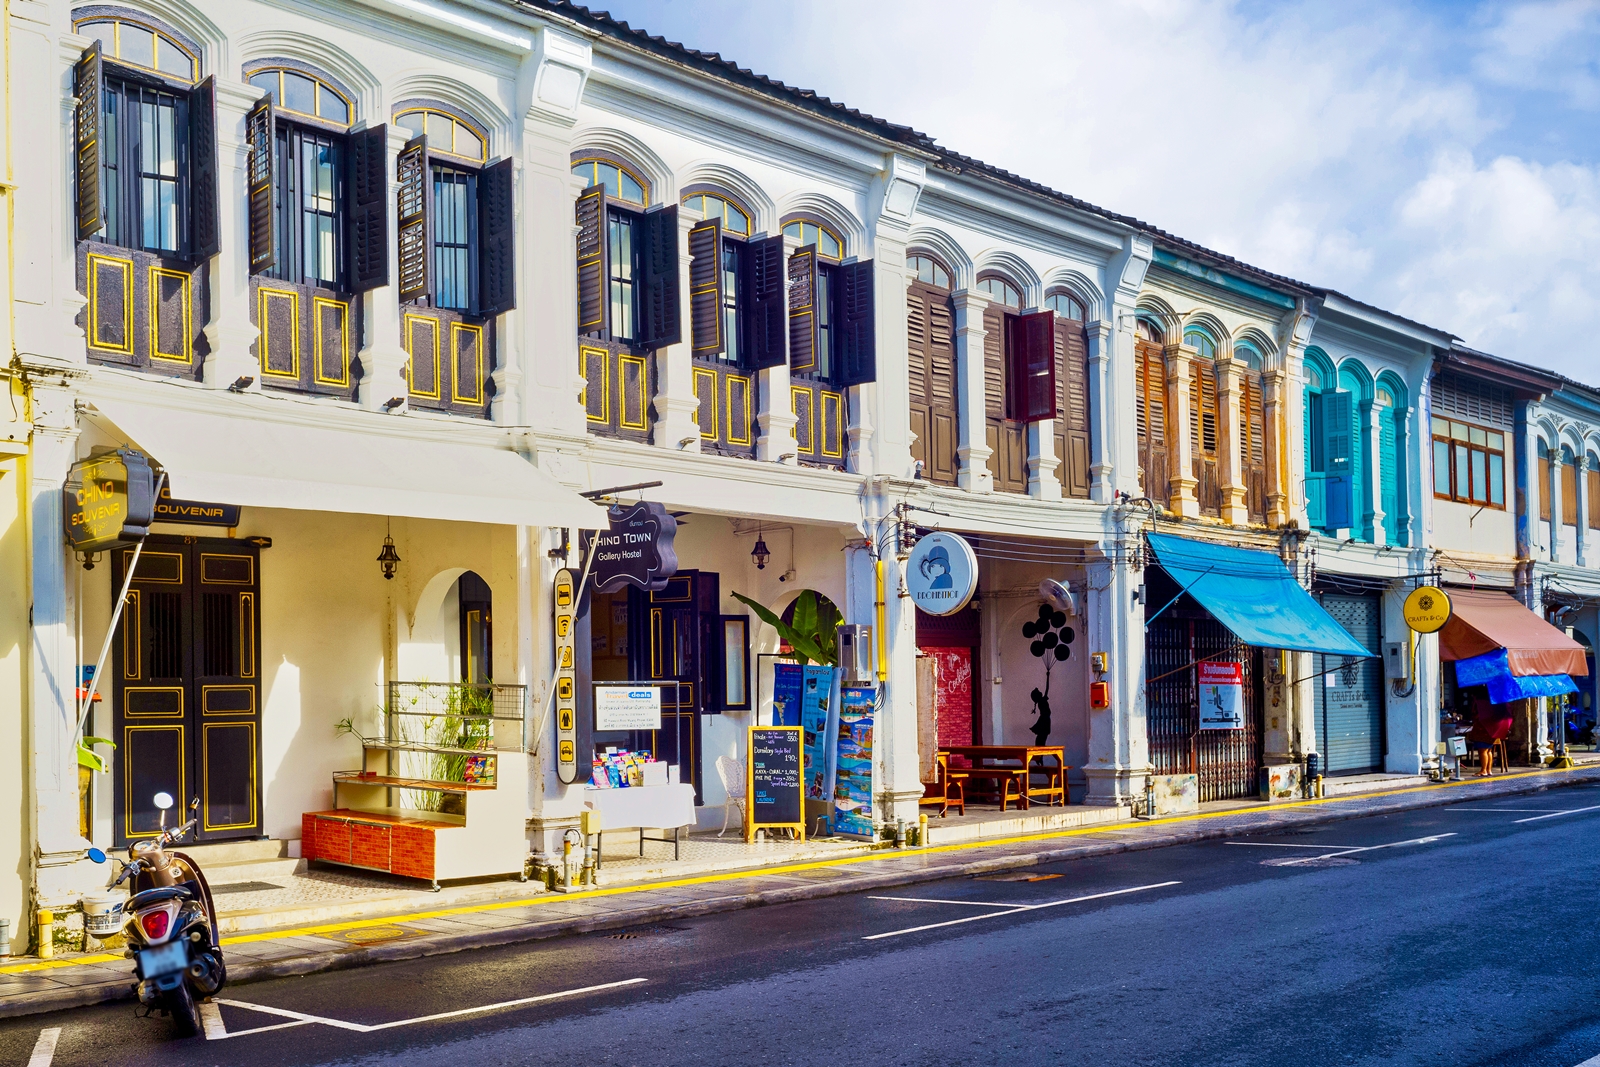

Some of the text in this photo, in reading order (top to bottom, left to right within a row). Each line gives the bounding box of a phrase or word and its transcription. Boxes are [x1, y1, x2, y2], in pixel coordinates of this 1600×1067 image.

[76, 481, 114, 506] CHINO
[71, 502, 120, 525] SOUVENIR
[623, 532, 651, 543] TOWN
[598, 549, 642, 561] Gallery Hostel
[1332, 690, 1355, 702] CRAFTs
